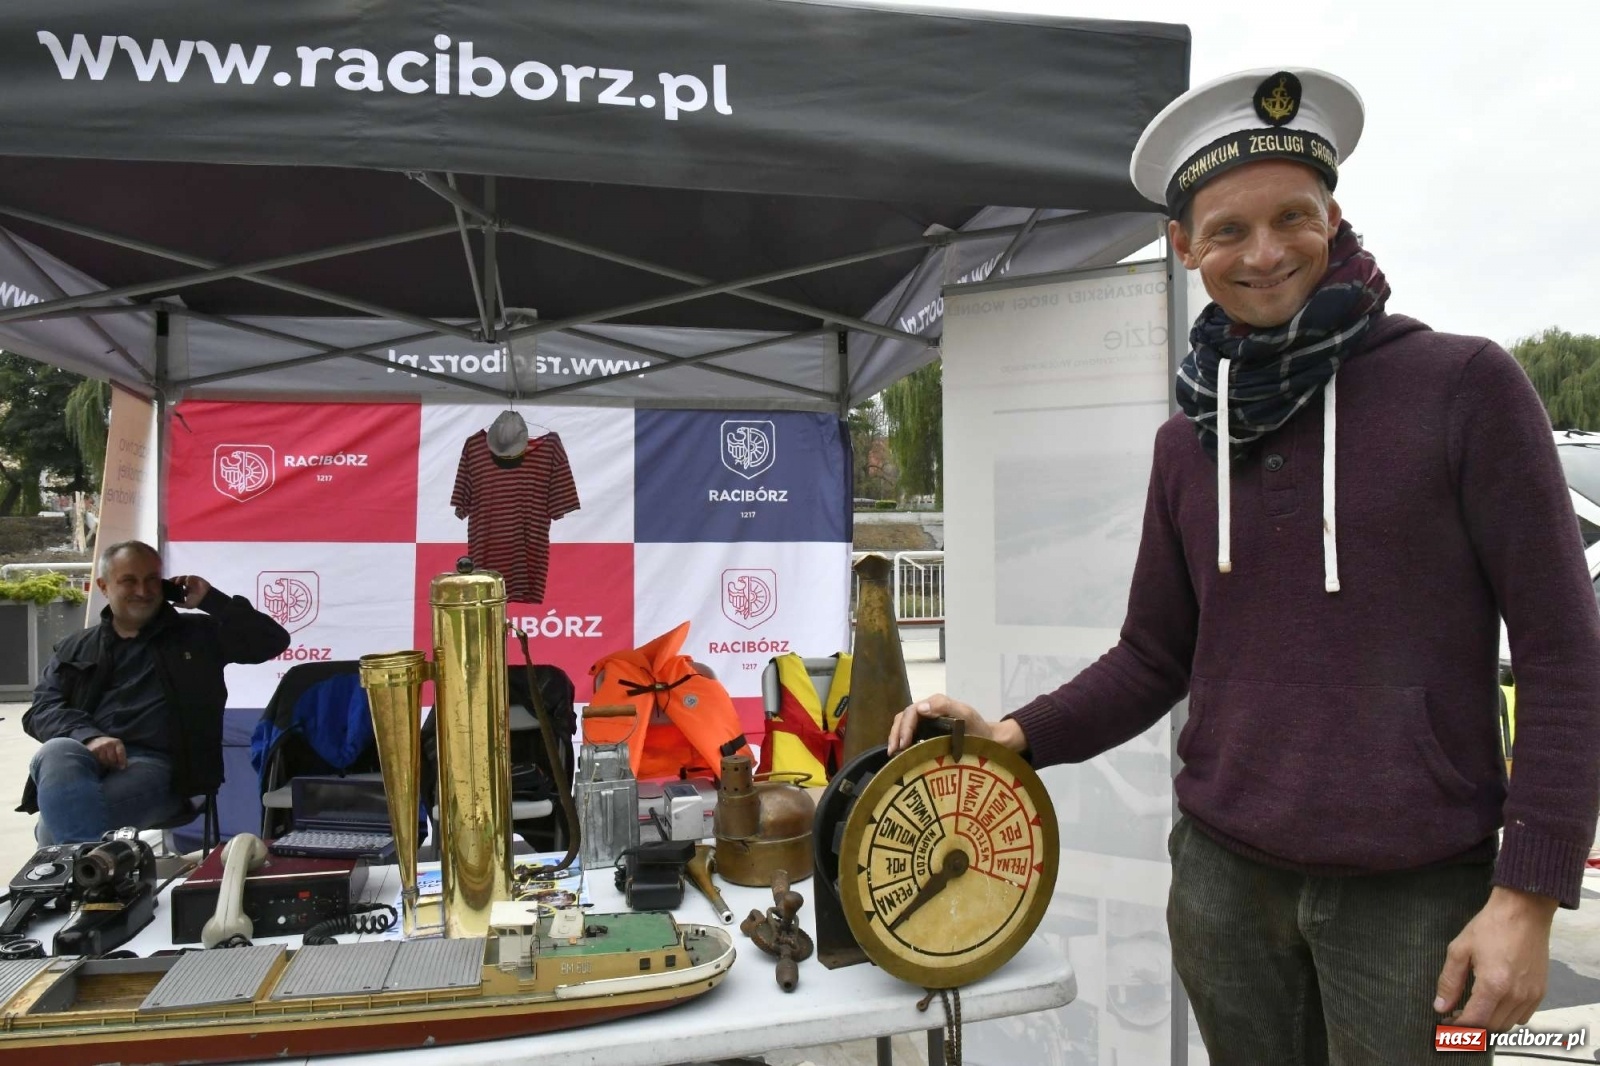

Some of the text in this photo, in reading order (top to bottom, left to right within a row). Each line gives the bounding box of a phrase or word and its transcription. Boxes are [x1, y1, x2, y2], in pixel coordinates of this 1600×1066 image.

[37, 30, 733, 121] www.raciborz.pl
[1178, 141, 1240, 191] TECHNIKUM
[1249, 134, 1304, 154] ŻEGLUGI
[284, 452, 368, 467] RACIBÓRZ
[317, 474, 333, 482] 1217
[709, 486, 788, 502] RACIBÓRZ
[506, 608, 603, 638] IBÓRZ
[709, 637, 790, 653] RACIBÓRZ
[930, 774, 957, 801] STÓJ
[963, 772, 986, 813] UWAGA
[902, 786, 933, 827] UWAGA
[981, 790, 1014, 827] WOLNO
[967, 822, 990, 863] WSTECZ
[999, 821, 1023, 846] PÓŁ
[886, 857, 907, 878] PÓŁ
[997, 857, 1028, 876] PEŁNA
[877, 883, 914, 916] PEŁNA
